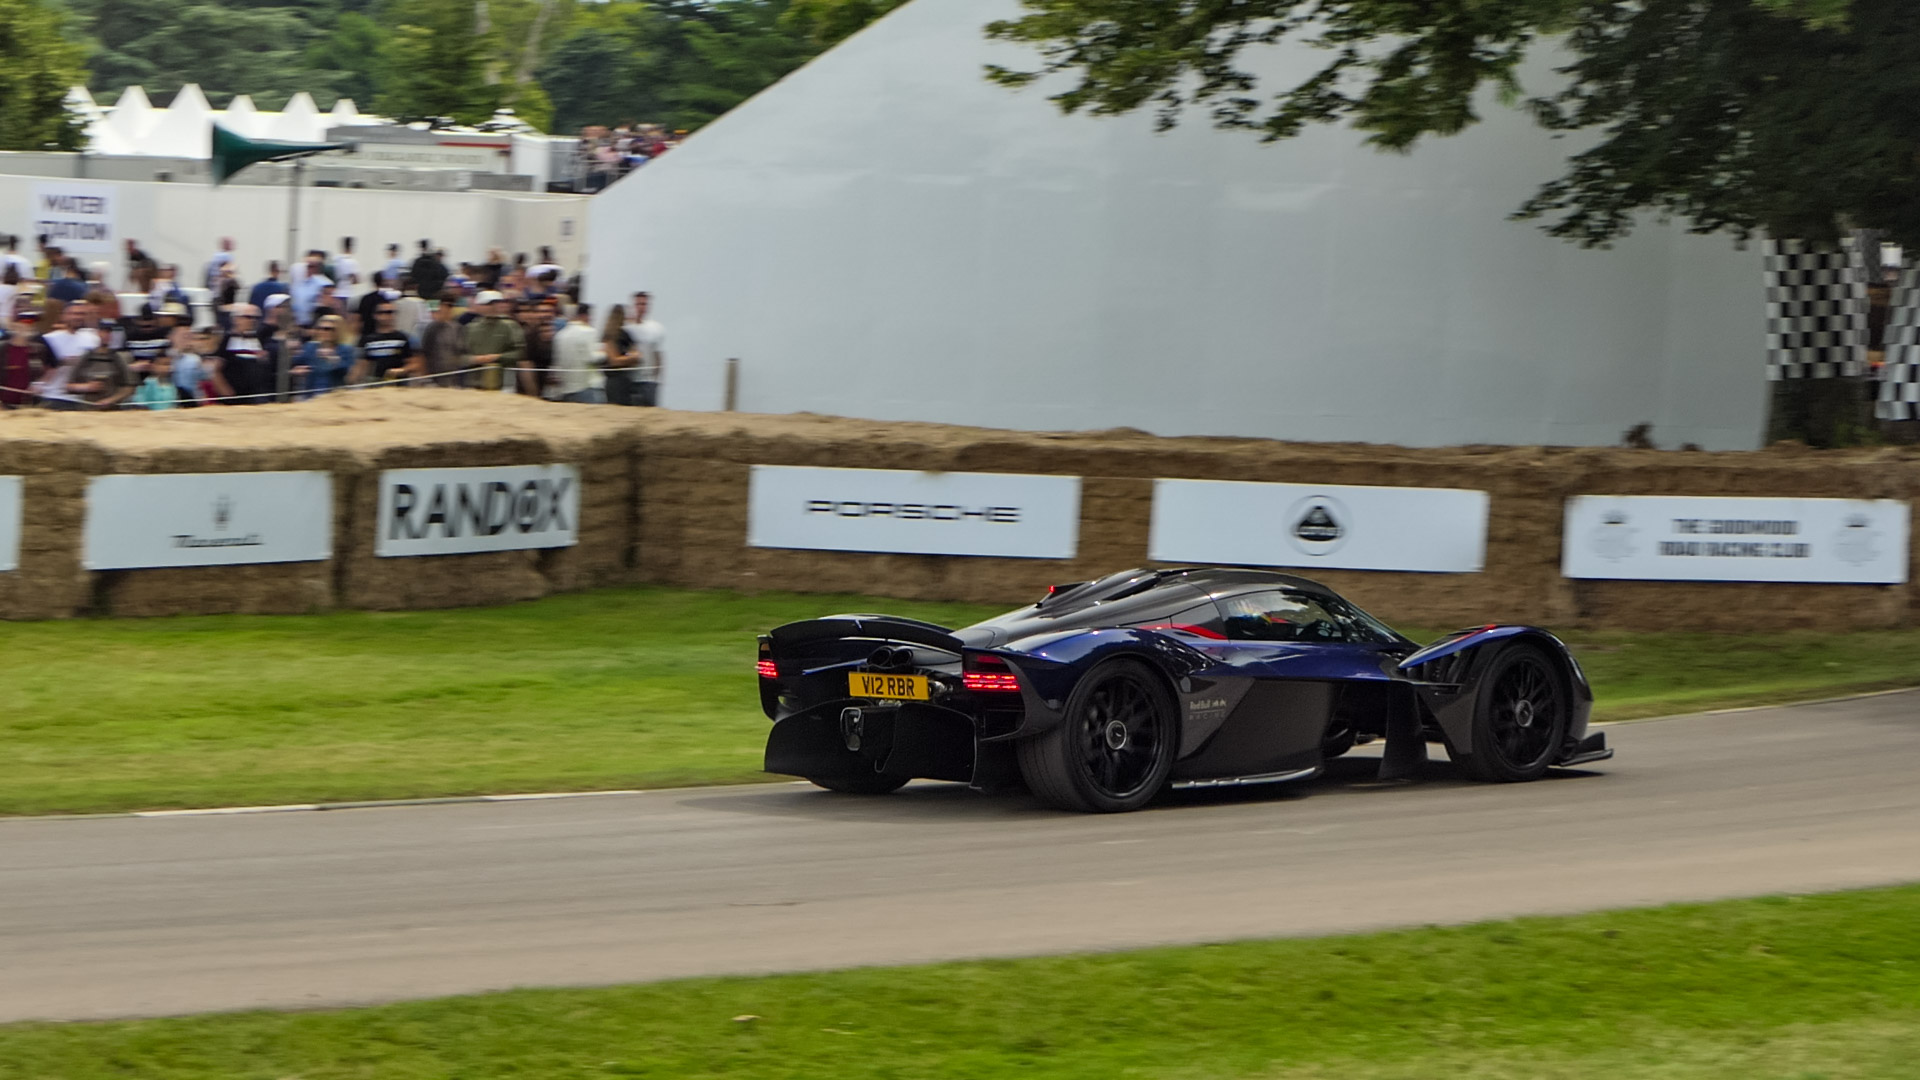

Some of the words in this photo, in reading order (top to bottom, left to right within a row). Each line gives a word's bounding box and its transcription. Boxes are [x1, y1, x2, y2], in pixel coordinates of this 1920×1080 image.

[389, 478, 572, 540] RANDOX
[804, 499, 1020, 523] PORSCHE
[861, 675, 884, 695] V12
[887, 677, 915, 697] RBR
